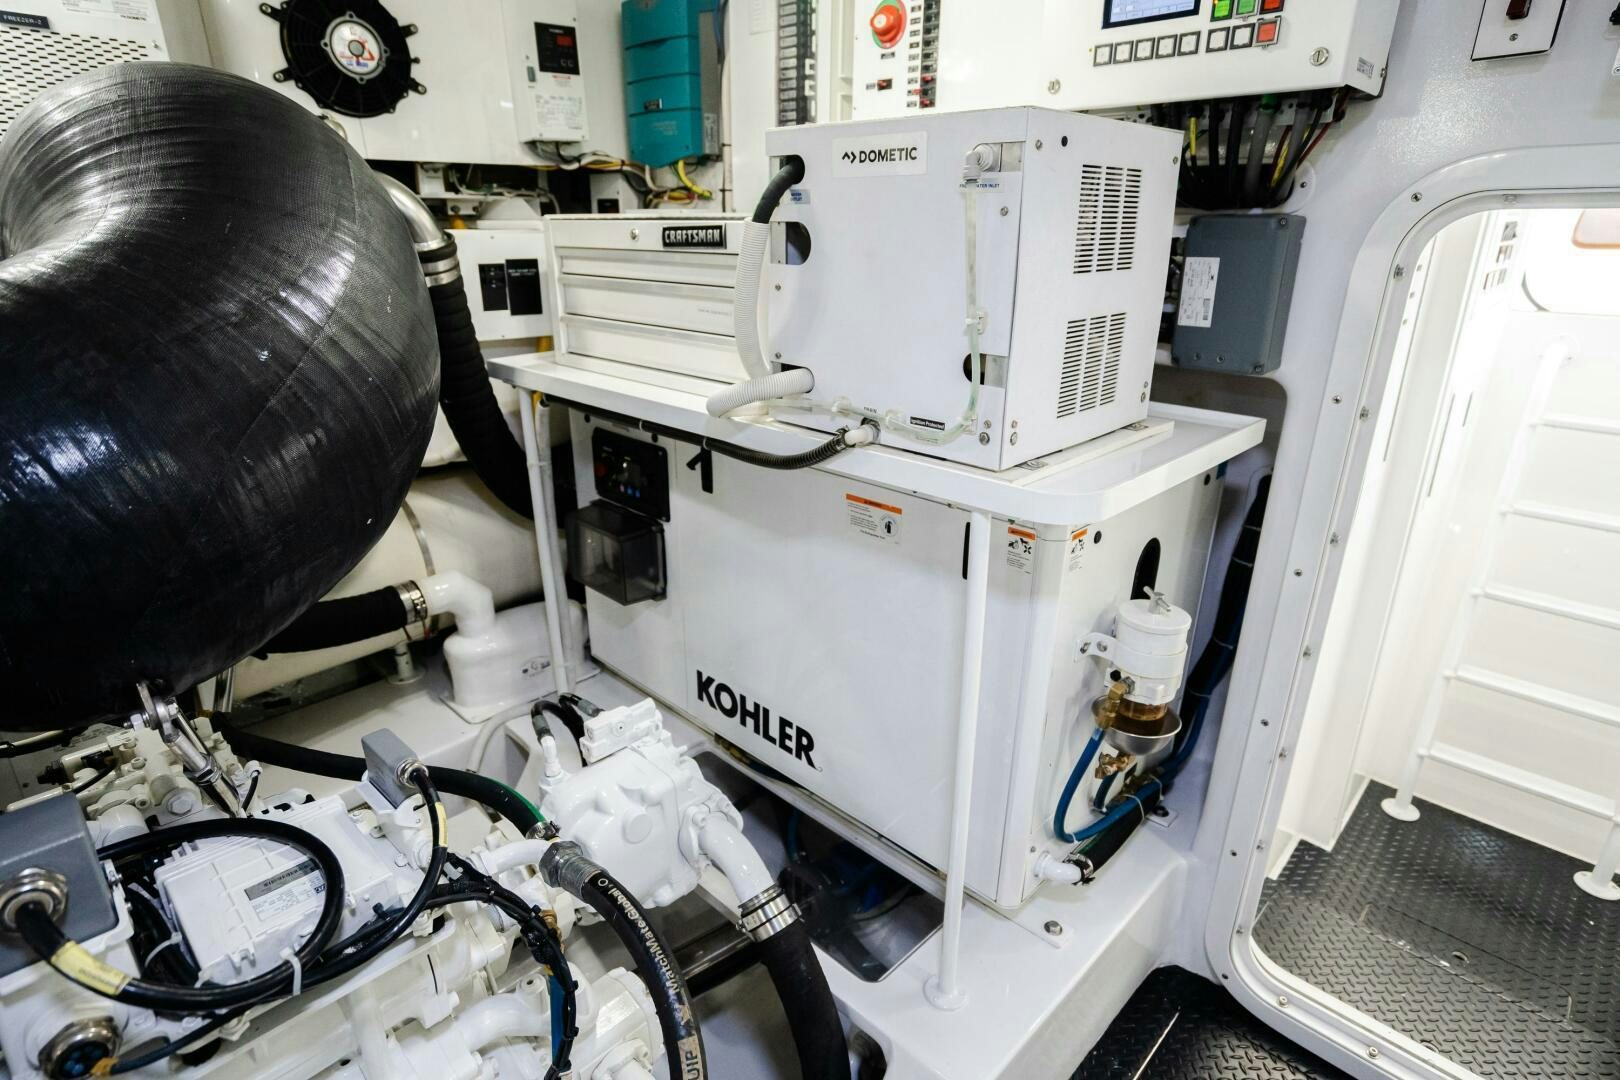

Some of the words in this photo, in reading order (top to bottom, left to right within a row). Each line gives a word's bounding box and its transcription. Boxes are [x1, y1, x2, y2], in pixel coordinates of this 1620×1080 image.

[858, 147, 918, 164] DOMETIC
[664, 228, 720, 243] CRAFTSMAN
[696, 669, 818, 770] KOHLER
[637, 918, 680, 994] MatchMate
